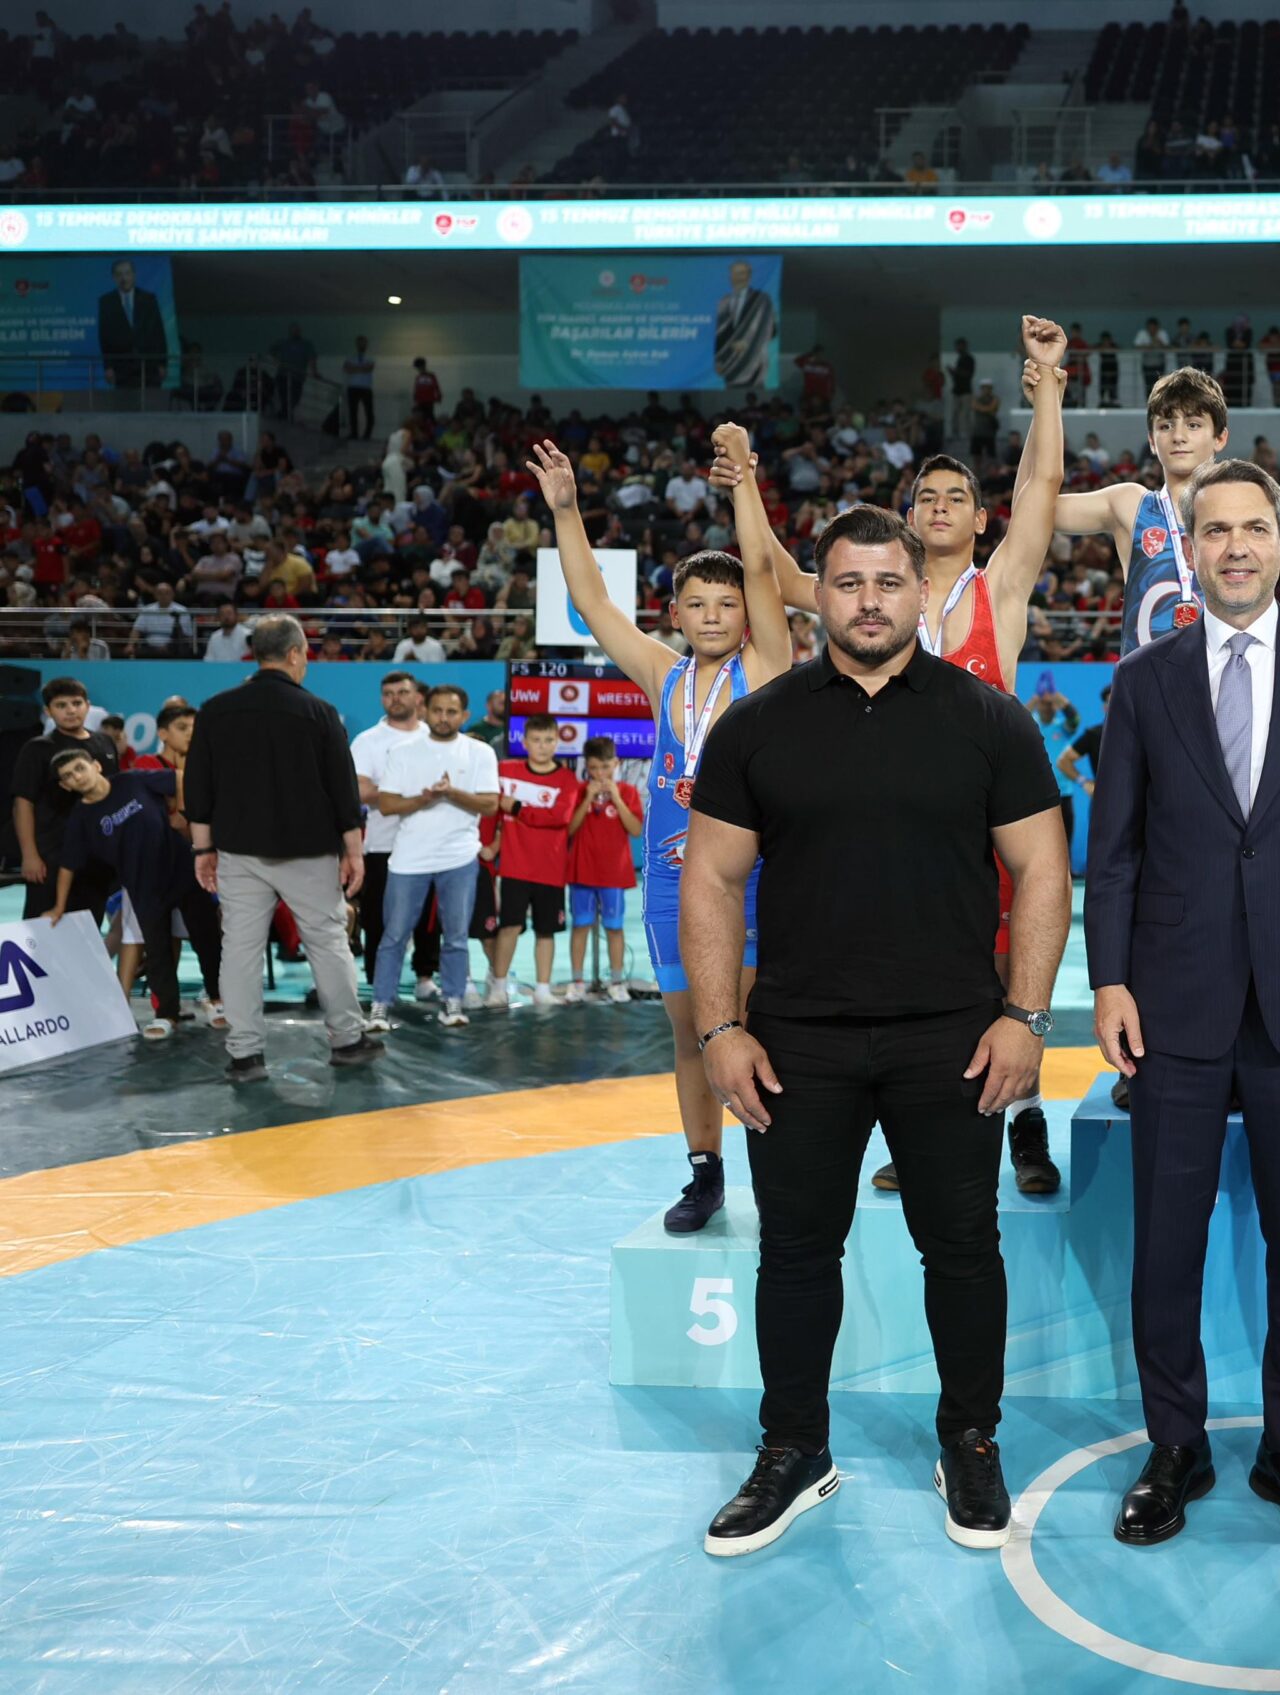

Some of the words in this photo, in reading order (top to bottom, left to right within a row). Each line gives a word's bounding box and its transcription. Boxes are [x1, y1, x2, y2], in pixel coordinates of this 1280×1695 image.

[37, 213, 53, 228] 15
[59, 212, 123, 227] TEMMUZ
[126, 210, 220, 227] DEMOKRASİ
[223, 211, 243, 226] VE
[245, 209, 289, 226] MİLLİ
[291, 209, 343, 225] BİRLİK
[128, 228, 195, 244] TÜRKİYE
[198, 227, 330, 244] ŞAMPİYONALARI
[511, 663, 530, 675] FS
[539, 663, 567, 677] 120
[595, 667, 604, 678] 0
[510, 690, 541, 703] UWW
[686, 1277, 738, 1346] 5
